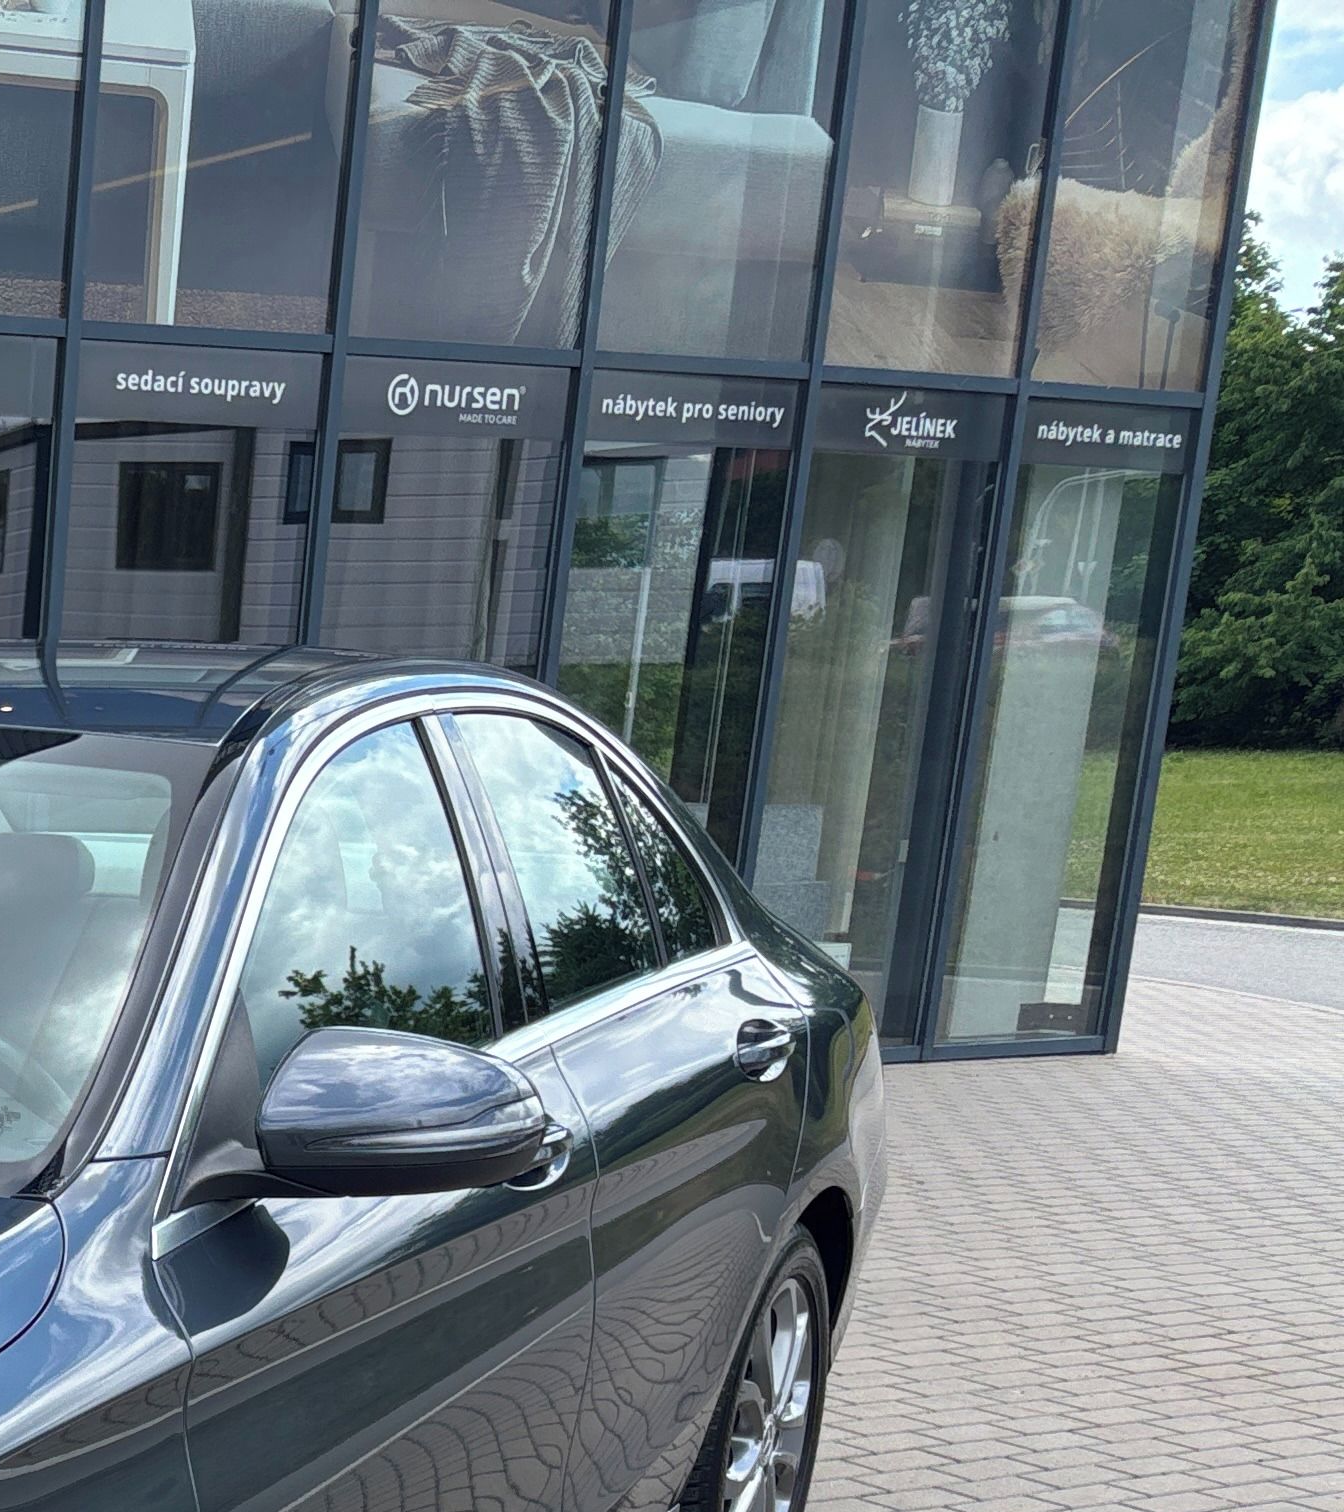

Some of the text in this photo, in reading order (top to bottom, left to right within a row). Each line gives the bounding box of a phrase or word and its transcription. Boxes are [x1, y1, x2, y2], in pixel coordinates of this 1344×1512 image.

[116, 369, 286, 404] sedací soupravy
[424, 383, 519, 411] nursen
[458, 413, 519, 425] MADE TO CARE
[601, 393, 785, 428] nábytek pro seniory
[891, 410, 958, 440] JELÍNEK
[905, 438, 941, 450] NÁBYTEK
[1037, 420, 1182, 449] nábytek a matrace
